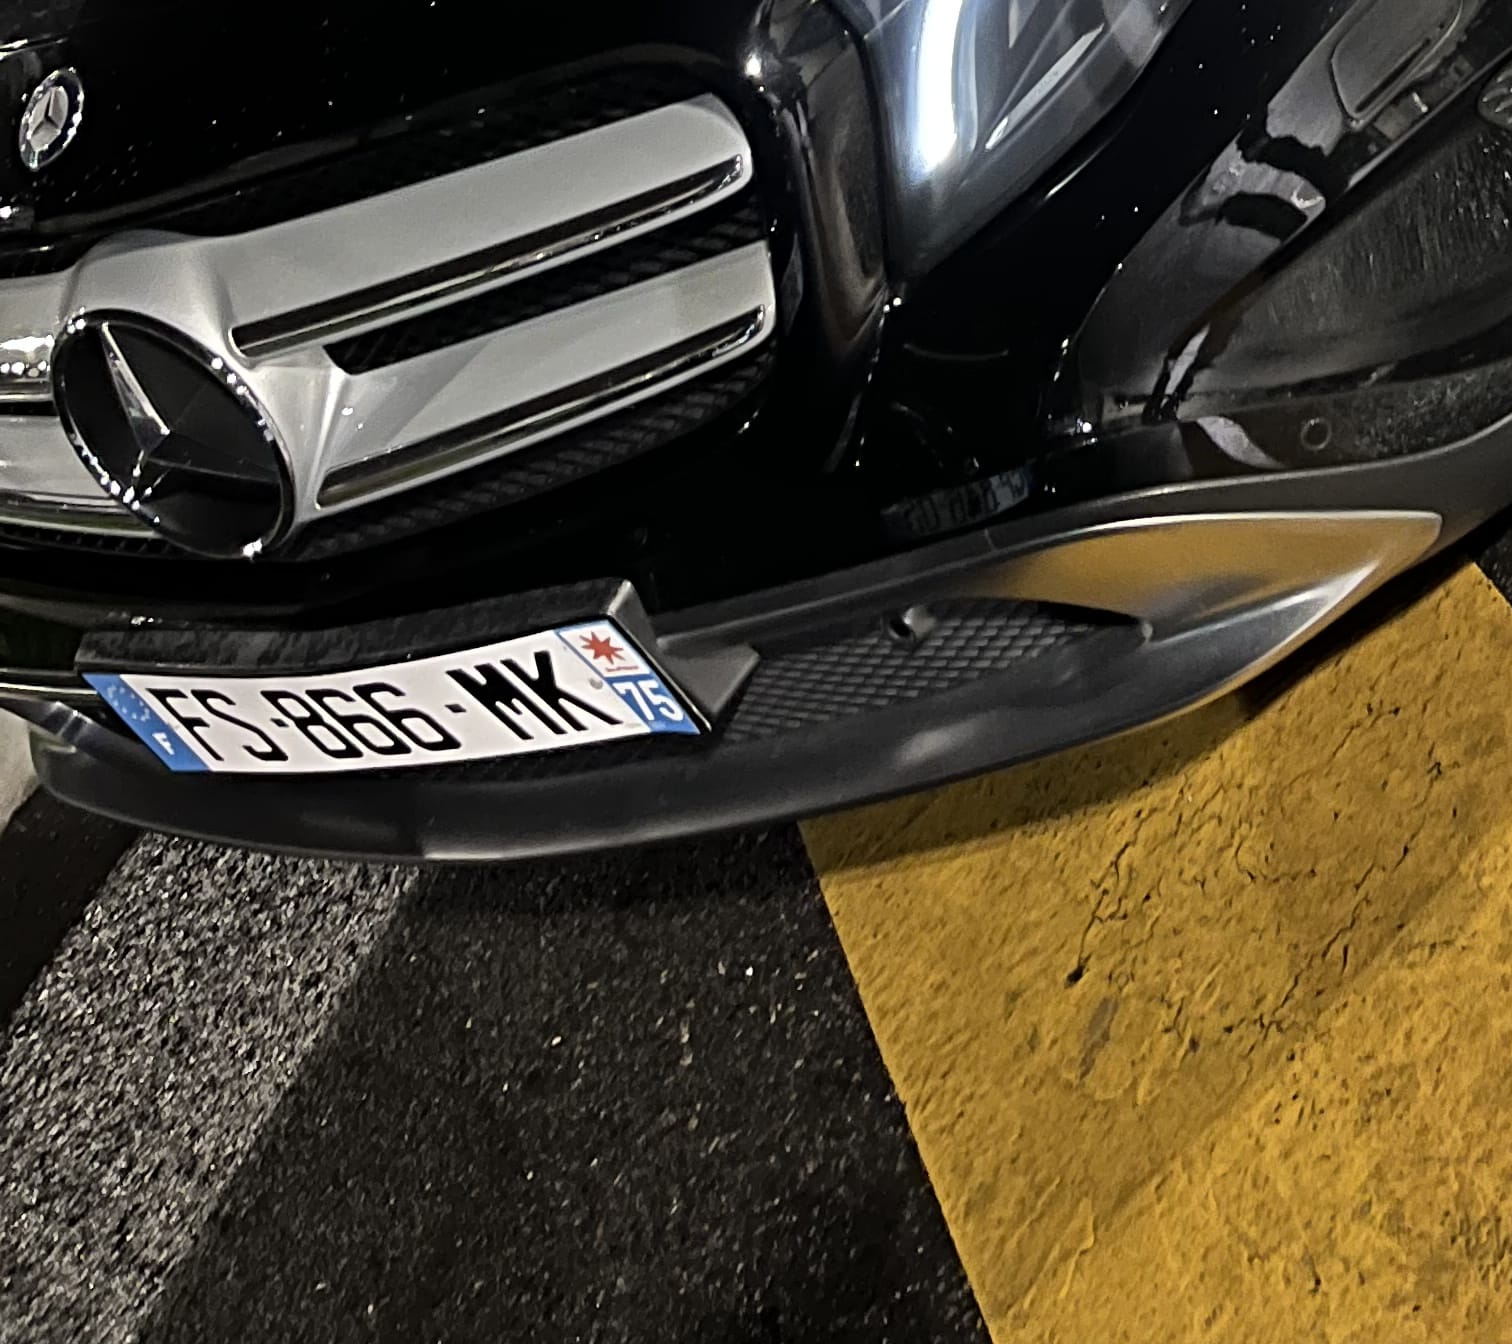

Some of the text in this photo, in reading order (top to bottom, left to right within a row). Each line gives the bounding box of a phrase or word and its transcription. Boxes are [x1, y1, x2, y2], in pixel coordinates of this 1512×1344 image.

[146, 650, 624, 761] FS-866-MK
[612, 679, 685, 722] 75
[151, 731, 176, 756] F
